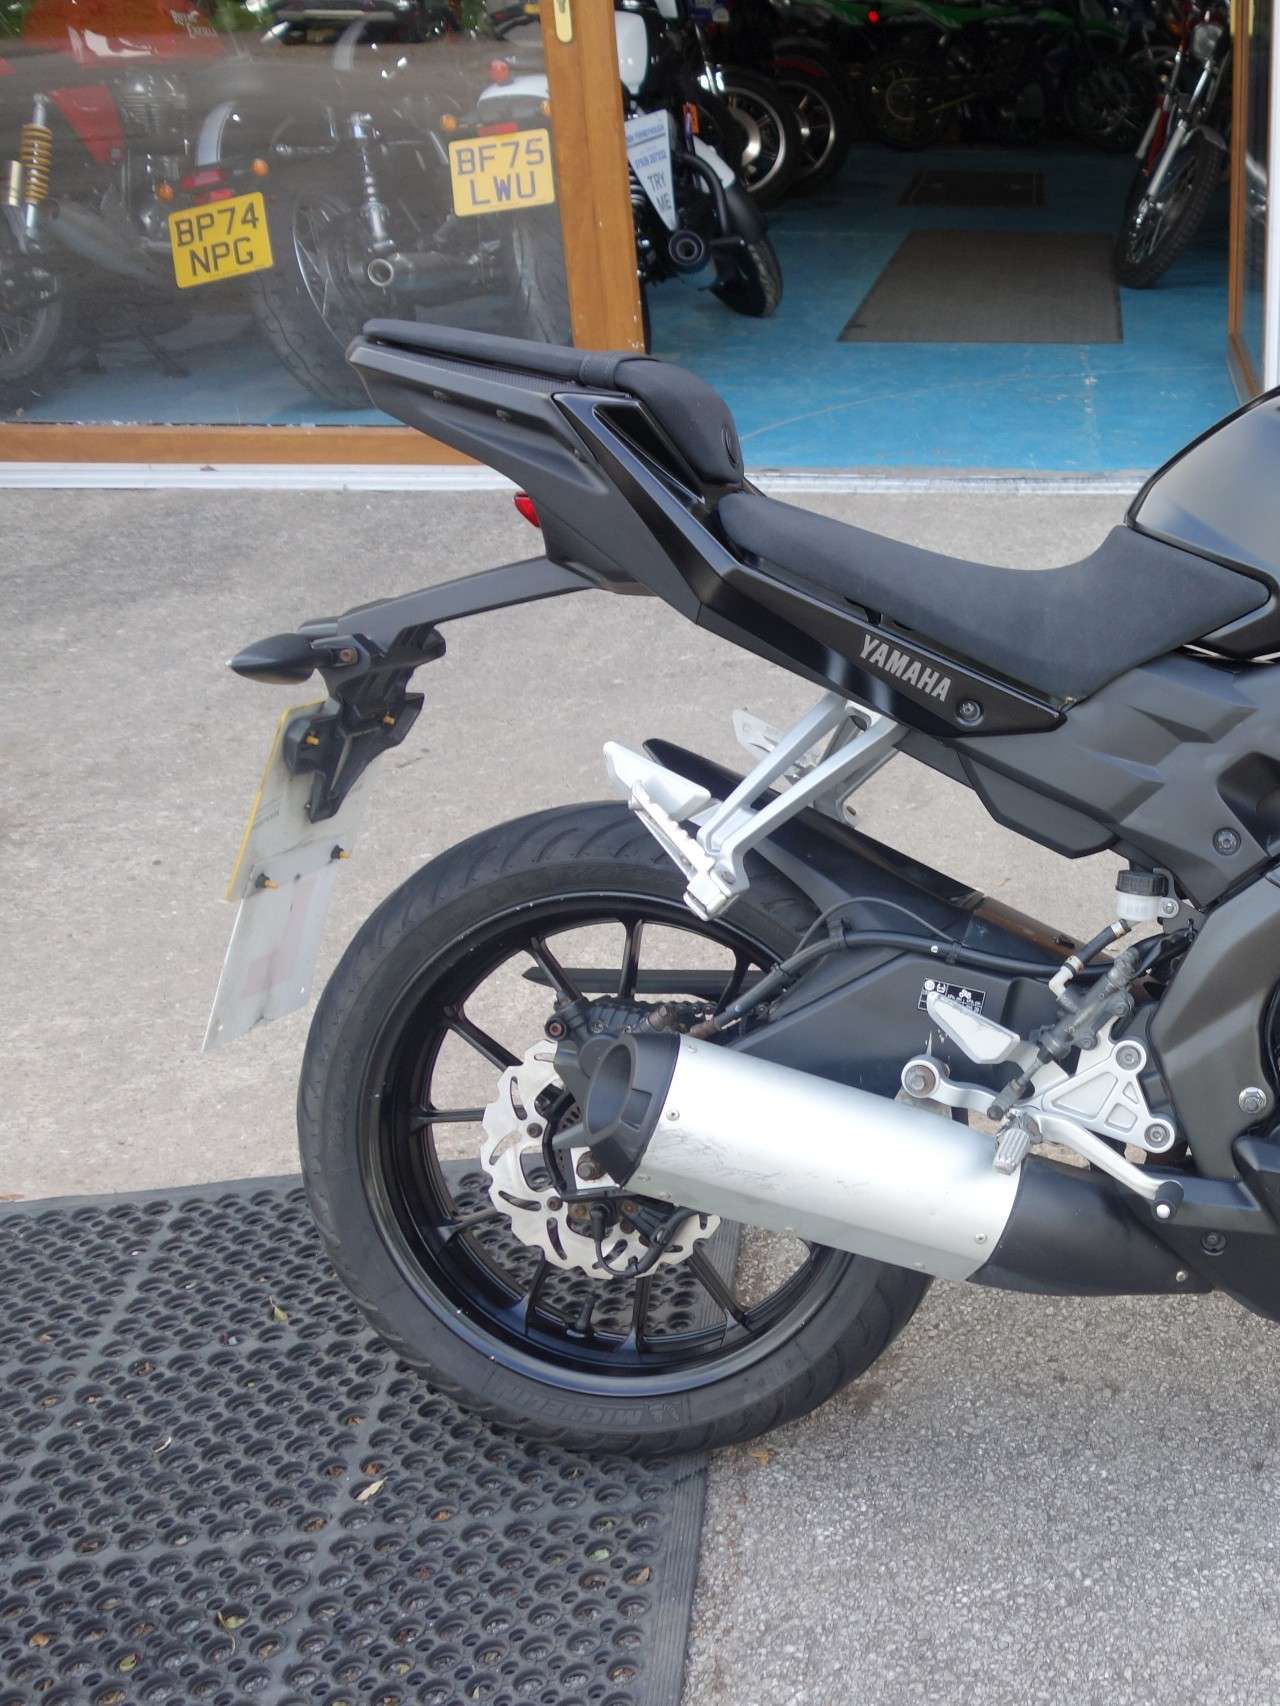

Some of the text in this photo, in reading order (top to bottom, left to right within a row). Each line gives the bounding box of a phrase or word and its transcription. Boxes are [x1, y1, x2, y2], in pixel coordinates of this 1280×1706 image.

[455, 138, 544, 175] BF75
[470, 170, 536, 206] LWU
[647, 171, 667, 192] TRY
[656, 192, 672, 210] ME
[175, 202, 259, 247] BP74
[189, 236, 254, 276] NPG
[860, 634, 951, 702] YAMAHA
